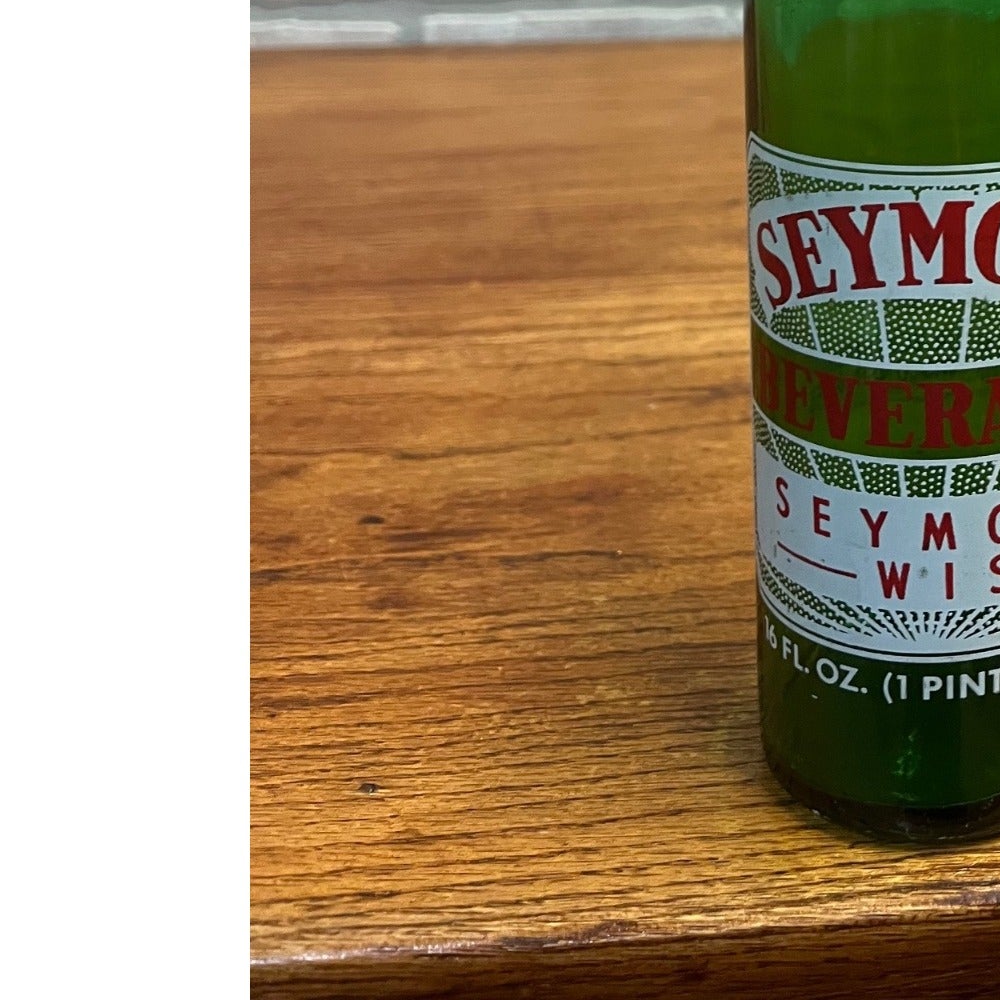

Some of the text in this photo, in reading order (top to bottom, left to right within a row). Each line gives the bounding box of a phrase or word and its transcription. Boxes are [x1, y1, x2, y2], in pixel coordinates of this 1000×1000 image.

[763, 614, 778, 650] 16
[781, 635, 810, 675] FL.
[815, 656, 869, 694] OZ.
[882, 671, 908, 704] (1
